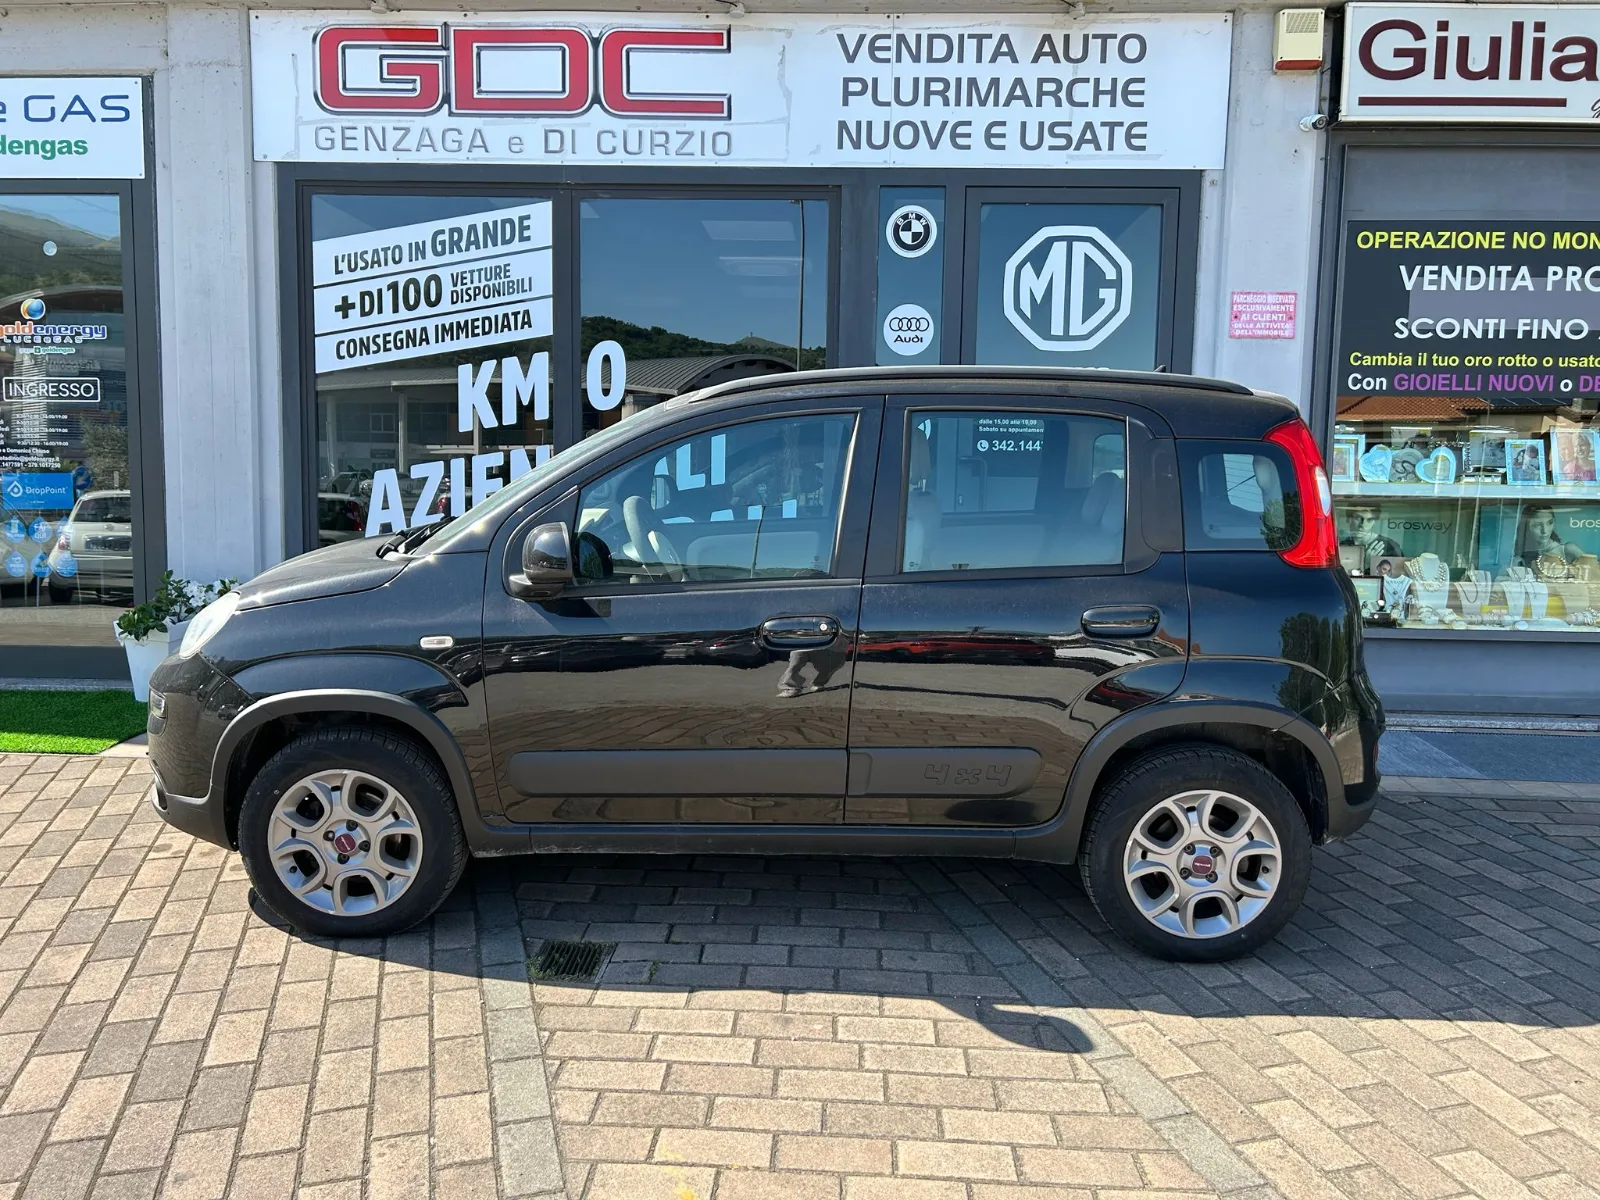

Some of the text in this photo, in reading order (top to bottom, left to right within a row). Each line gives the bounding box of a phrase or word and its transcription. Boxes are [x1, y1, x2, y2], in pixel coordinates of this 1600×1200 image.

[836, 33, 1147, 64] VENDITA AUTO
[1358, 19, 1599, 82] Giulia
[313, 21, 731, 120] GDC
[841, 76, 1145, 108] PLURIMARCHE
[24, 94, 130, 122] GAS
[314, 125, 733, 157] GENZAGA e DI CURZIO
[837, 120, 1148, 151] NUOVE E USATE
[334, 214, 531, 275] L'USATO IN GRANDE
[1356, 231, 1506, 249] OPERAZIONE
[1512, 231, 1546, 250] NO
[450, 263, 511, 288] VETTURE
[1019, 240, 1117, 336] MG
[1399, 265, 1535, 291] VENDITA
[450, 277, 533, 305] DISPONIBILI
[335, 308, 532, 360] CONSEGNA IMMEDIATA
[893, 334, 923, 343] Audi
[1393, 317, 1589, 340] SCONTI FINO
[1349, 352, 1412, 366] Cambia
[1417, 352, 1427, 366] il
[1431, 354, 1459, 367] tuo
[1464, 356, 1493, 367] oro
[1497, 354, 1538, 367] rotto
[1542, 356, 1553, 367] o
[9, 383, 95, 397] INGRESSO
[457, 351, 549, 433] KM
[1347, 373, 1387, 391] Con
[1393, 373, 1482, 391] GIOIELLI
[1488, 374, 1554, 392] NUOVI
[1560, 379, 1573, 392] o
[992, 440, 1043, 451] 342.144
[1387, 518, 1452, 534] brosway
[924, 764, 1012, 786] 4x4
